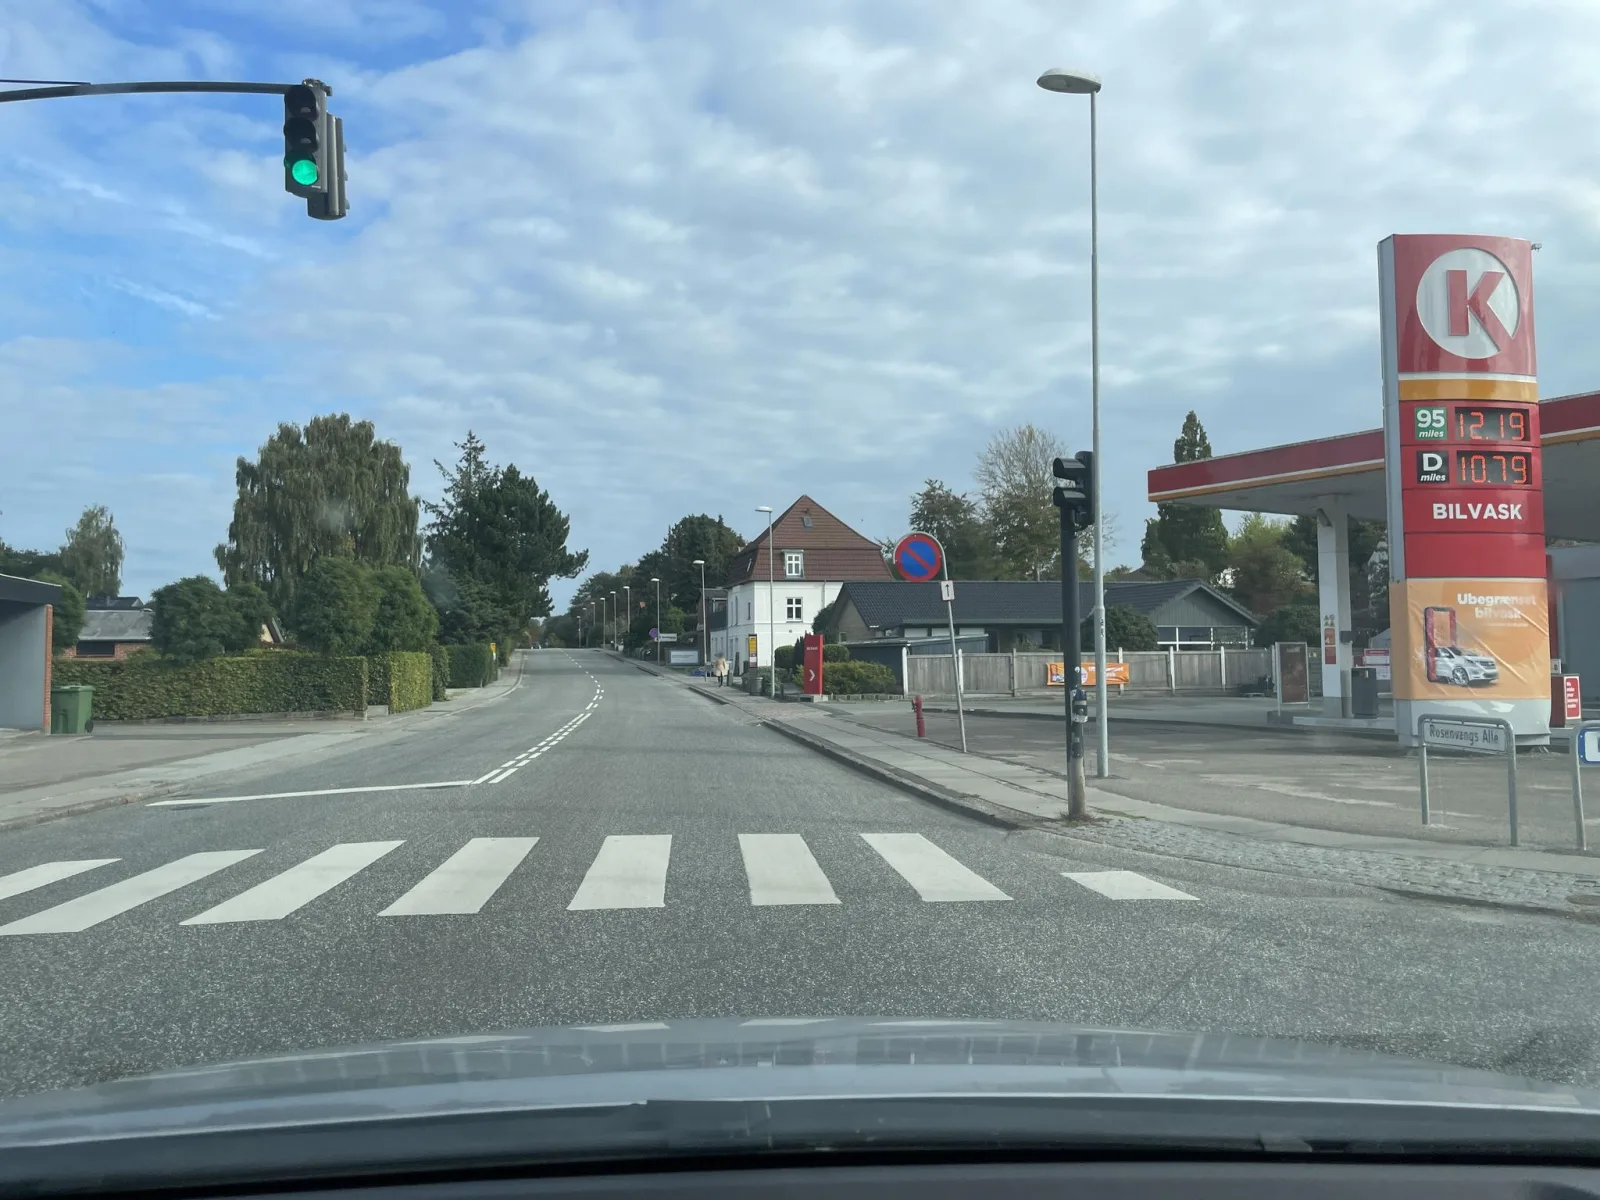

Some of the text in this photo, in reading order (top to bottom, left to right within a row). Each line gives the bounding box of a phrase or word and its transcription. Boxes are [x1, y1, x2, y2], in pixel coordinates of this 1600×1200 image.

[1446, 269, 1514, 352] K
[1417, 409, 1445, 428] 95
[1459, 411, 1525, 441] 12.19
[1418, 429, 1444, 439] miles
[1422, 453, 1443, 472] D
[1461, 454, 1527, 484] 10.79
[1420, 473, 1446, 483] miles
[1432, 503, 1523, 521] BILVASK
